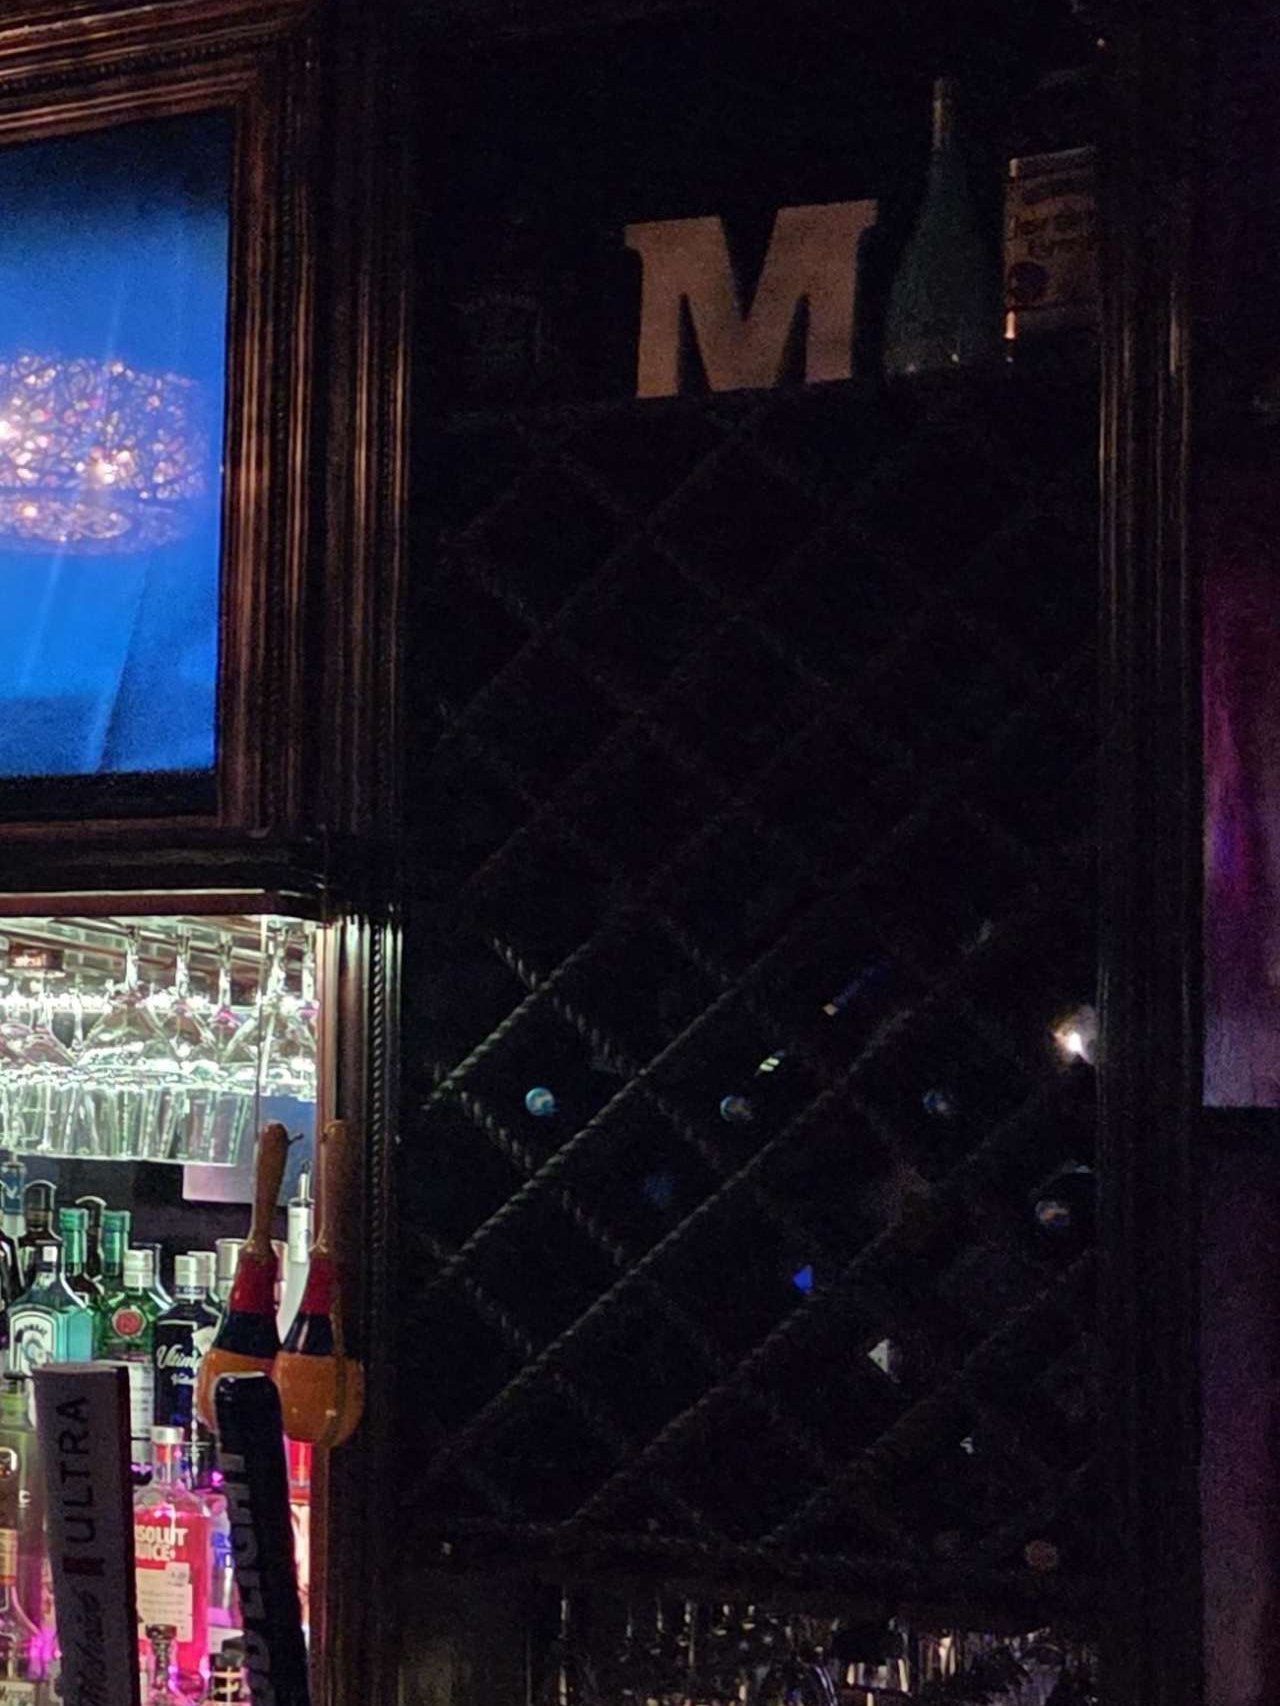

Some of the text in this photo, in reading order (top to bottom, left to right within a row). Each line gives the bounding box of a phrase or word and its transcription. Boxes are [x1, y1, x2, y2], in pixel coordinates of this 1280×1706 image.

[625, 199, 878, 399] M
[56, 1396, 96, 1543] ULTRA
[135, 1524, 189, 1547] SOLUT
